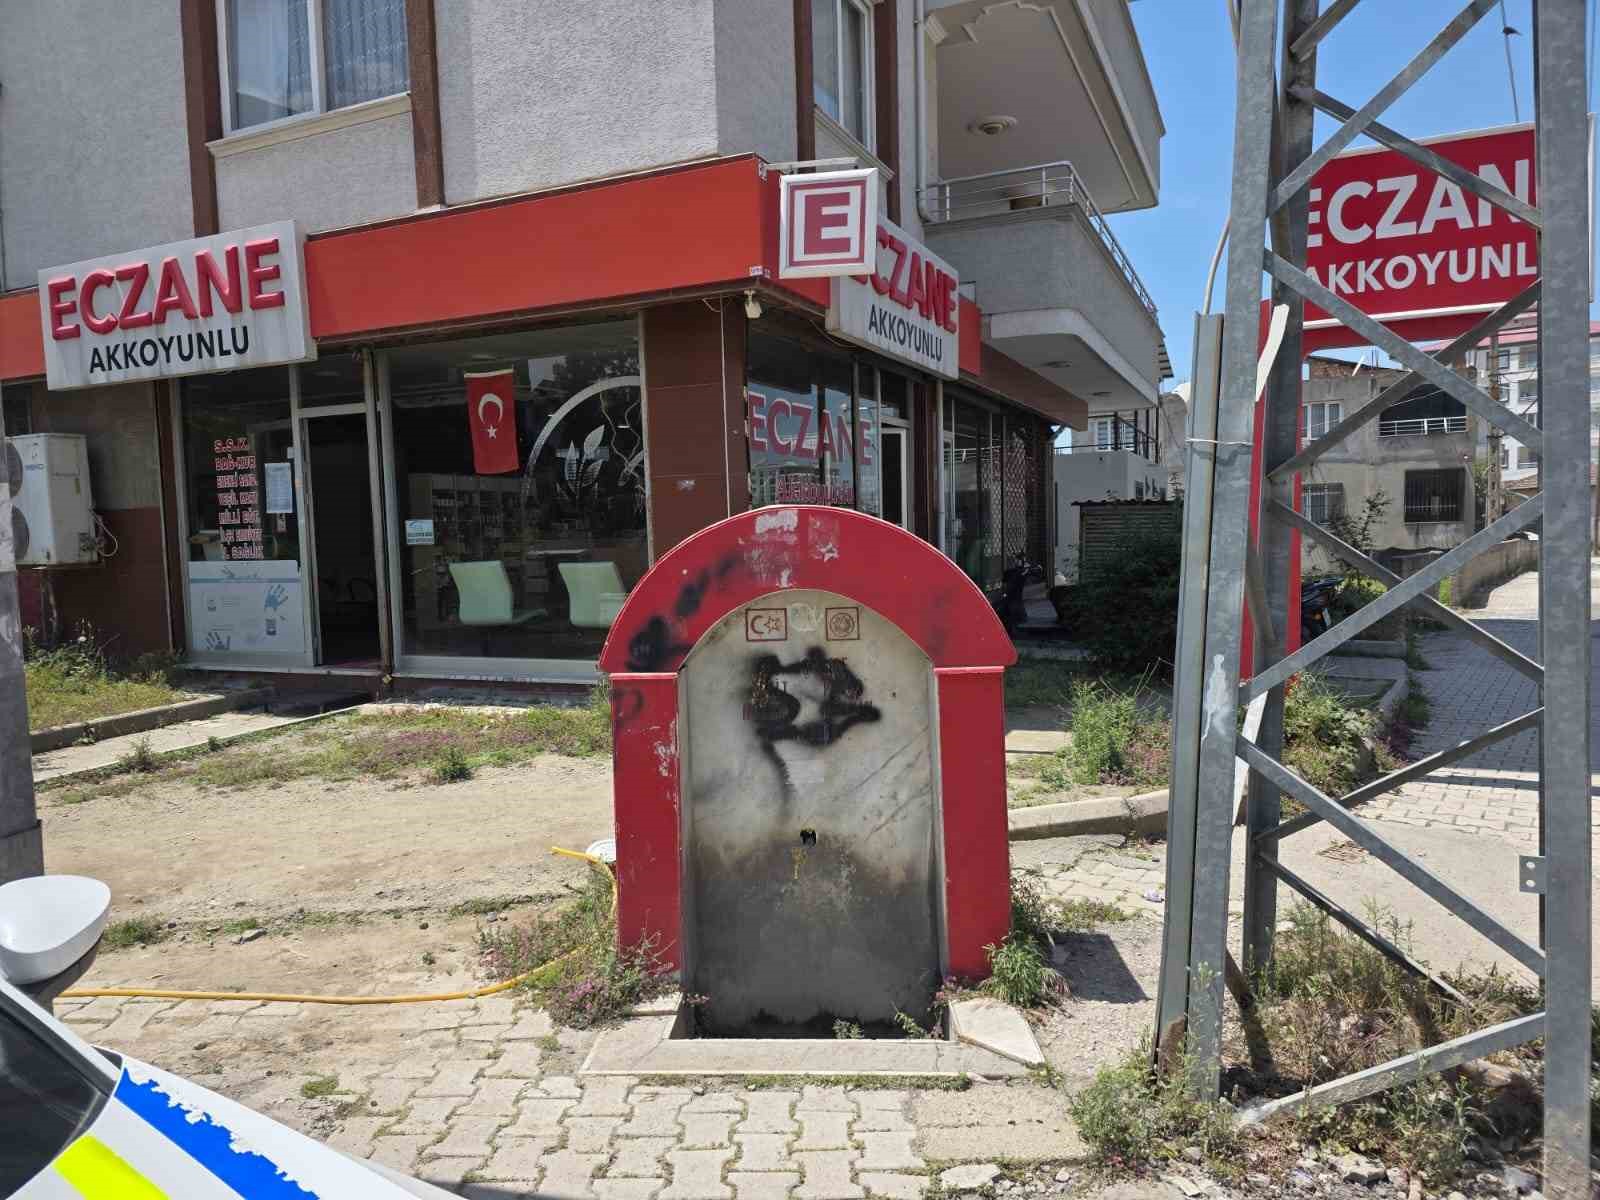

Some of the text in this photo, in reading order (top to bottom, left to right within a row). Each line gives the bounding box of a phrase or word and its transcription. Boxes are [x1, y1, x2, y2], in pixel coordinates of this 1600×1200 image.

[804, 191, 850, 256] E
[1305, 159, 1530, 249] ECZAN
[47, 238, 286, 341] ECZANE
[849, 223, 957, 334] CZANE
[1305, 242, 1538, 295] AKKOYUNL
[88, 325, 250, 374] AKKOYUNLU
[868, 303, 943, 363] AKKOYUNLU
[747, 391, 873, 466] ECZANE
